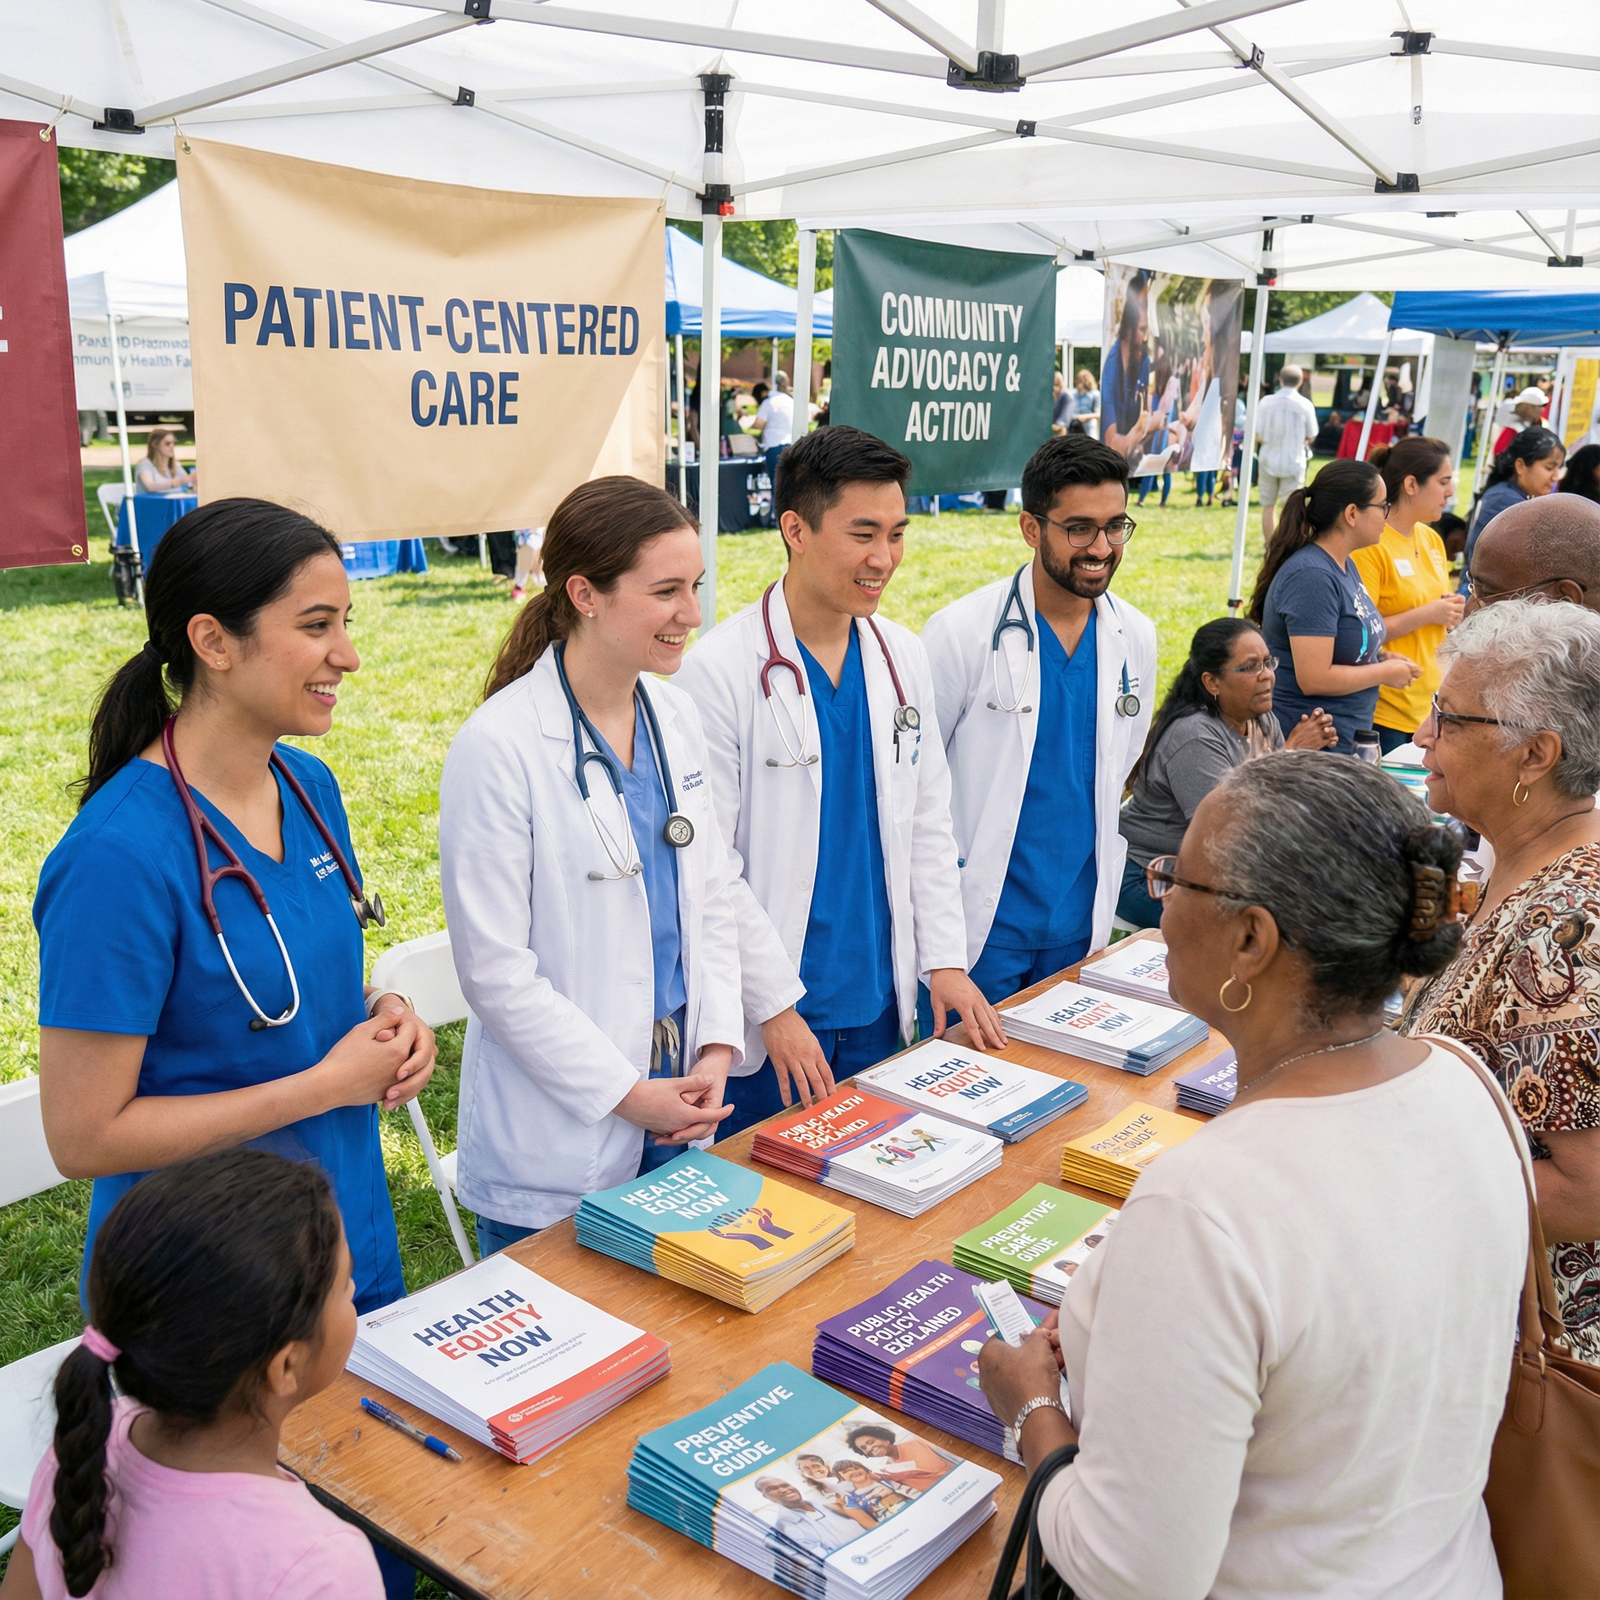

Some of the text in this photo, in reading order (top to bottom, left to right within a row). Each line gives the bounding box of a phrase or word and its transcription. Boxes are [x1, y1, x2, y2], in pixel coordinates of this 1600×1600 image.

[224, 282, 640, 356] PATIENT-CENTERED
[881, 291, 1024, 344] COMMUNITY
[870, 346, 1022, 394] ADVOCACY &
[410, 369, 519, 427] CARE
[904, 401, 991, 443] ACTION
[1045, 996, 1101, 1025] HEALTH
[1067, 1002, 1119, 1030] EQUITY
[1095, 1012, 1134, 1032] NOW
[904, 1057, 971, 1091] HEALTH
[926, 1064, 989, 1098] EQUITY
[958, 1075, 1004, 1101] NOW
[619, 1165, 704, 1207] HEALTH
[641, 1173, 720, 1217] EQUITY
[678, 1190, 731, 1220] NOW
[979, 1199, 1058, 1250] PREVENTIVE
[999, 1232, 1038, 1257] CARE
[1016, 1236, 1060, 1263] GUIDE
[412, 1289, 526, 1347] HEALTH
[846, 1271, 955, 1338] PUBLIC HEALTH
[437, 1303, 543, 1361] EQUITY
[477, 1325, 553, 1368] NOW
[864, 1311, 921, 1347] POLICY
[882, 1305, 963, 1356] EXPLAINED
[673, 1384, 795, 1455] PREVENTIVE
[693, 1433, 752, 1467] CARE
[711, 1439, 777, 1478] GUIDE
